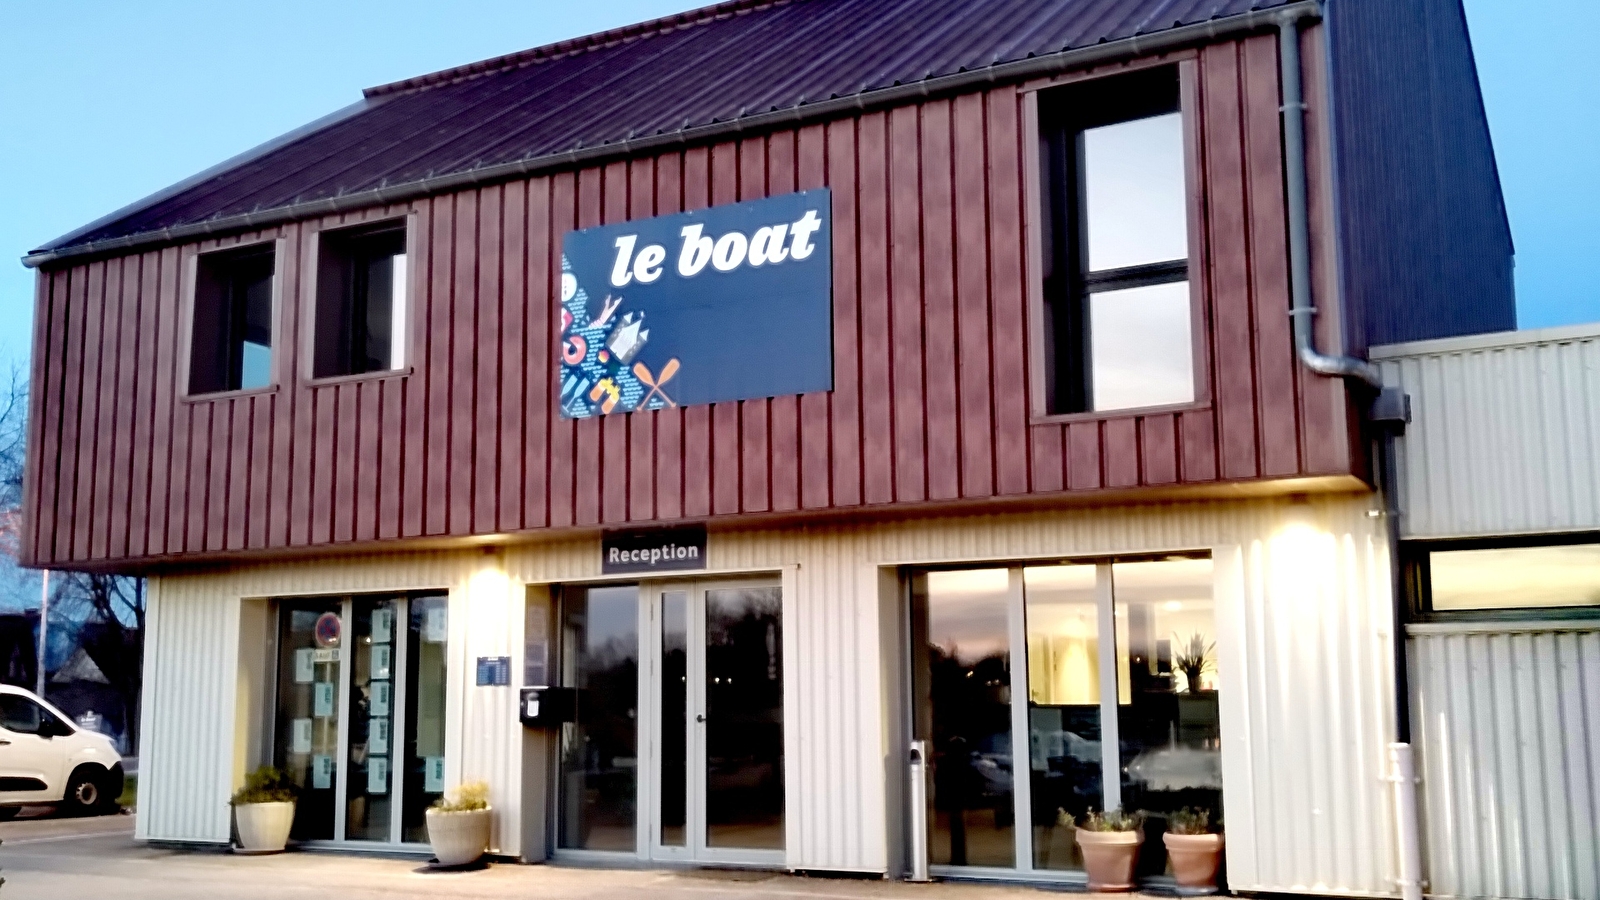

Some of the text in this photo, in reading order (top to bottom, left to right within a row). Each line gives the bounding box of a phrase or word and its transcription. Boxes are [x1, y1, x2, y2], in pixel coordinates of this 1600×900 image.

[611, 210, 822, 287] le boat
[609, 543, 699, 565] Reception
